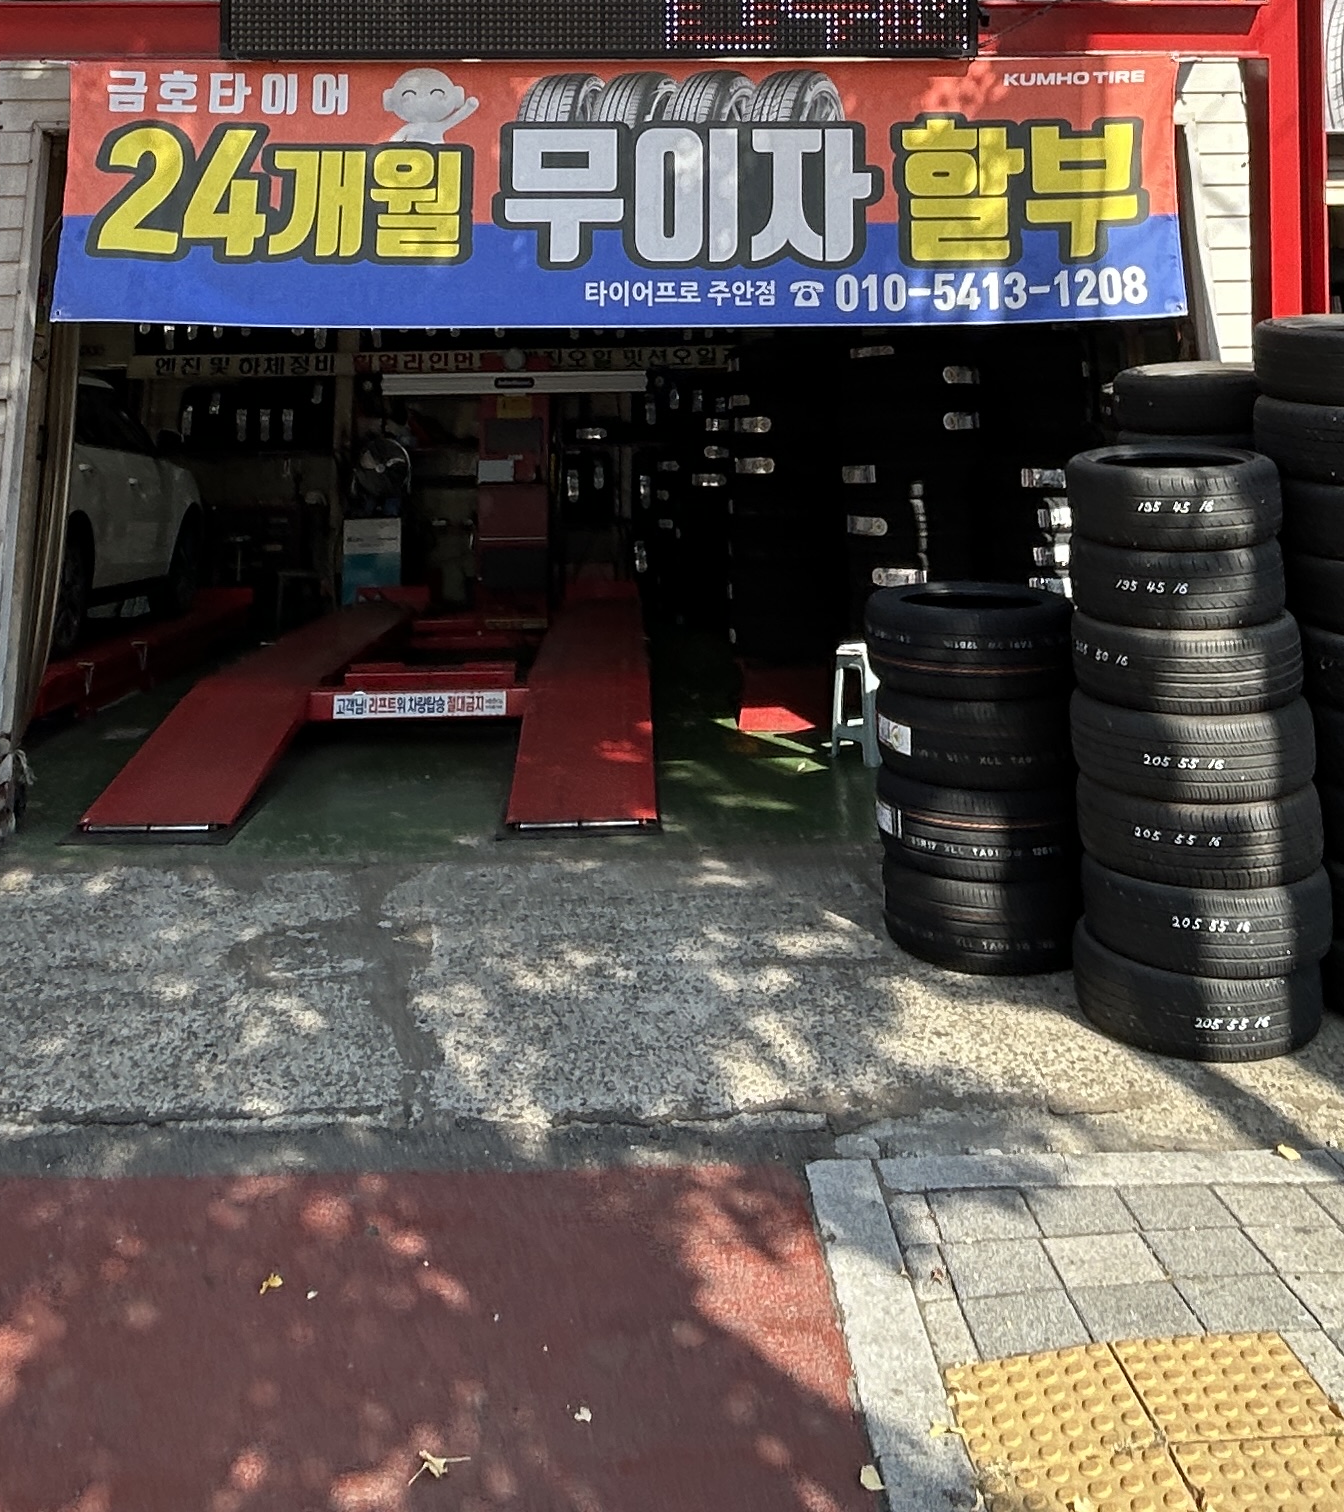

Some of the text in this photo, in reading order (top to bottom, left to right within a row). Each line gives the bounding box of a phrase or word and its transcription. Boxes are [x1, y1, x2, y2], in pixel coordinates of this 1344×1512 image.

[1002, 69, 1145, 85] KUMHO TIRE
[105, 70, 350, 117] 금호타이어
[93, 119, 1147, 265] 24개월 무이자 할부
[584, 266, 1149, 313] 타이어프로 주안점 010-5413-1208
[156, 355, 202, 376] 엔진
[240, 353, 335, 376] 하체정비
[1172, 501, 1191, 514] 45
[1146, 580, 1166, 595] 45
[1172, 582, 1189, 596] 16
[1142, 753, 1225, 771] 205 55 16
[1133, 826, 1162, 842] 205
[1173, 833, 1197, 846] 55
[1171, 915, 1203, 930] 205
[1194, 1015, 1271, 1032] 205 55 16
